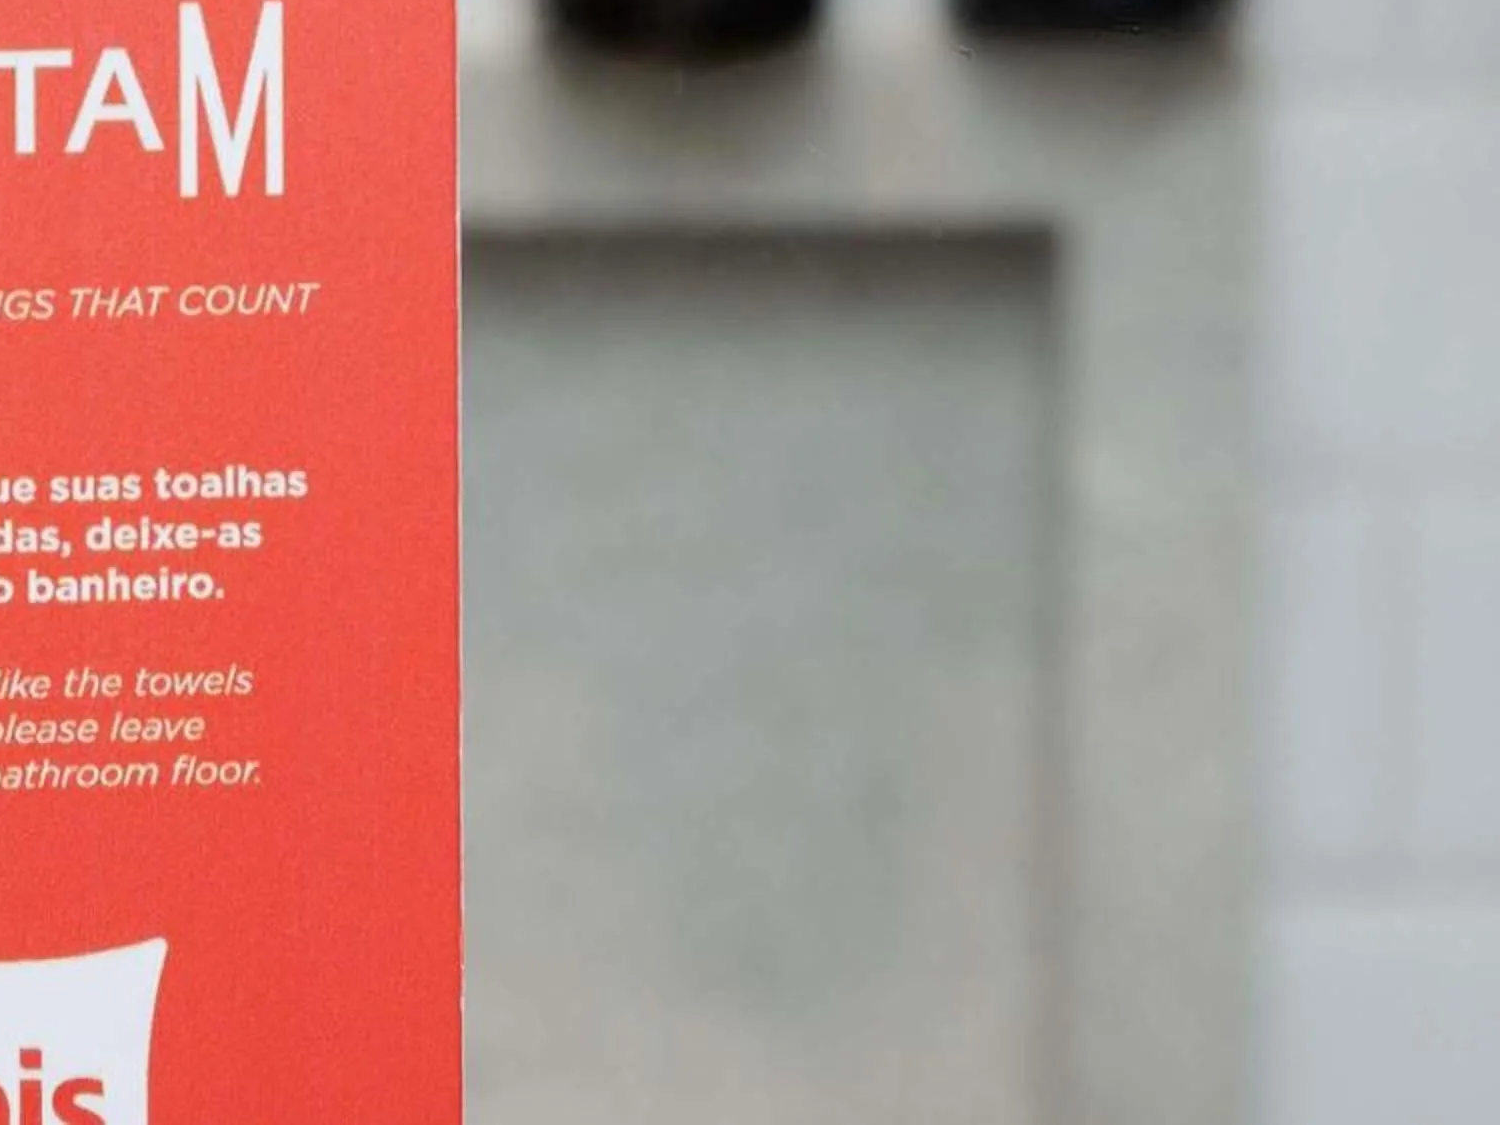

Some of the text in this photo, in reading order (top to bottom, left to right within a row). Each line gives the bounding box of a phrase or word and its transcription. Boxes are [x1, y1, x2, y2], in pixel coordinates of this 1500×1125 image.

[70, 285, 169, 318] THAT
[178, 282, 321, 316] COUNT
[49, 473, 142, 504] suas
[153, 464, 309, 501] toalhas
[84, 515, 263, 552] deixe-as
[27, 566, 225, 604] banheiro.
[63, 666, 122, 698] the
[134, 664, 253, 697] towels
[110, 712, 205, 743] leave
[171, 754, 259, 785] floor.
